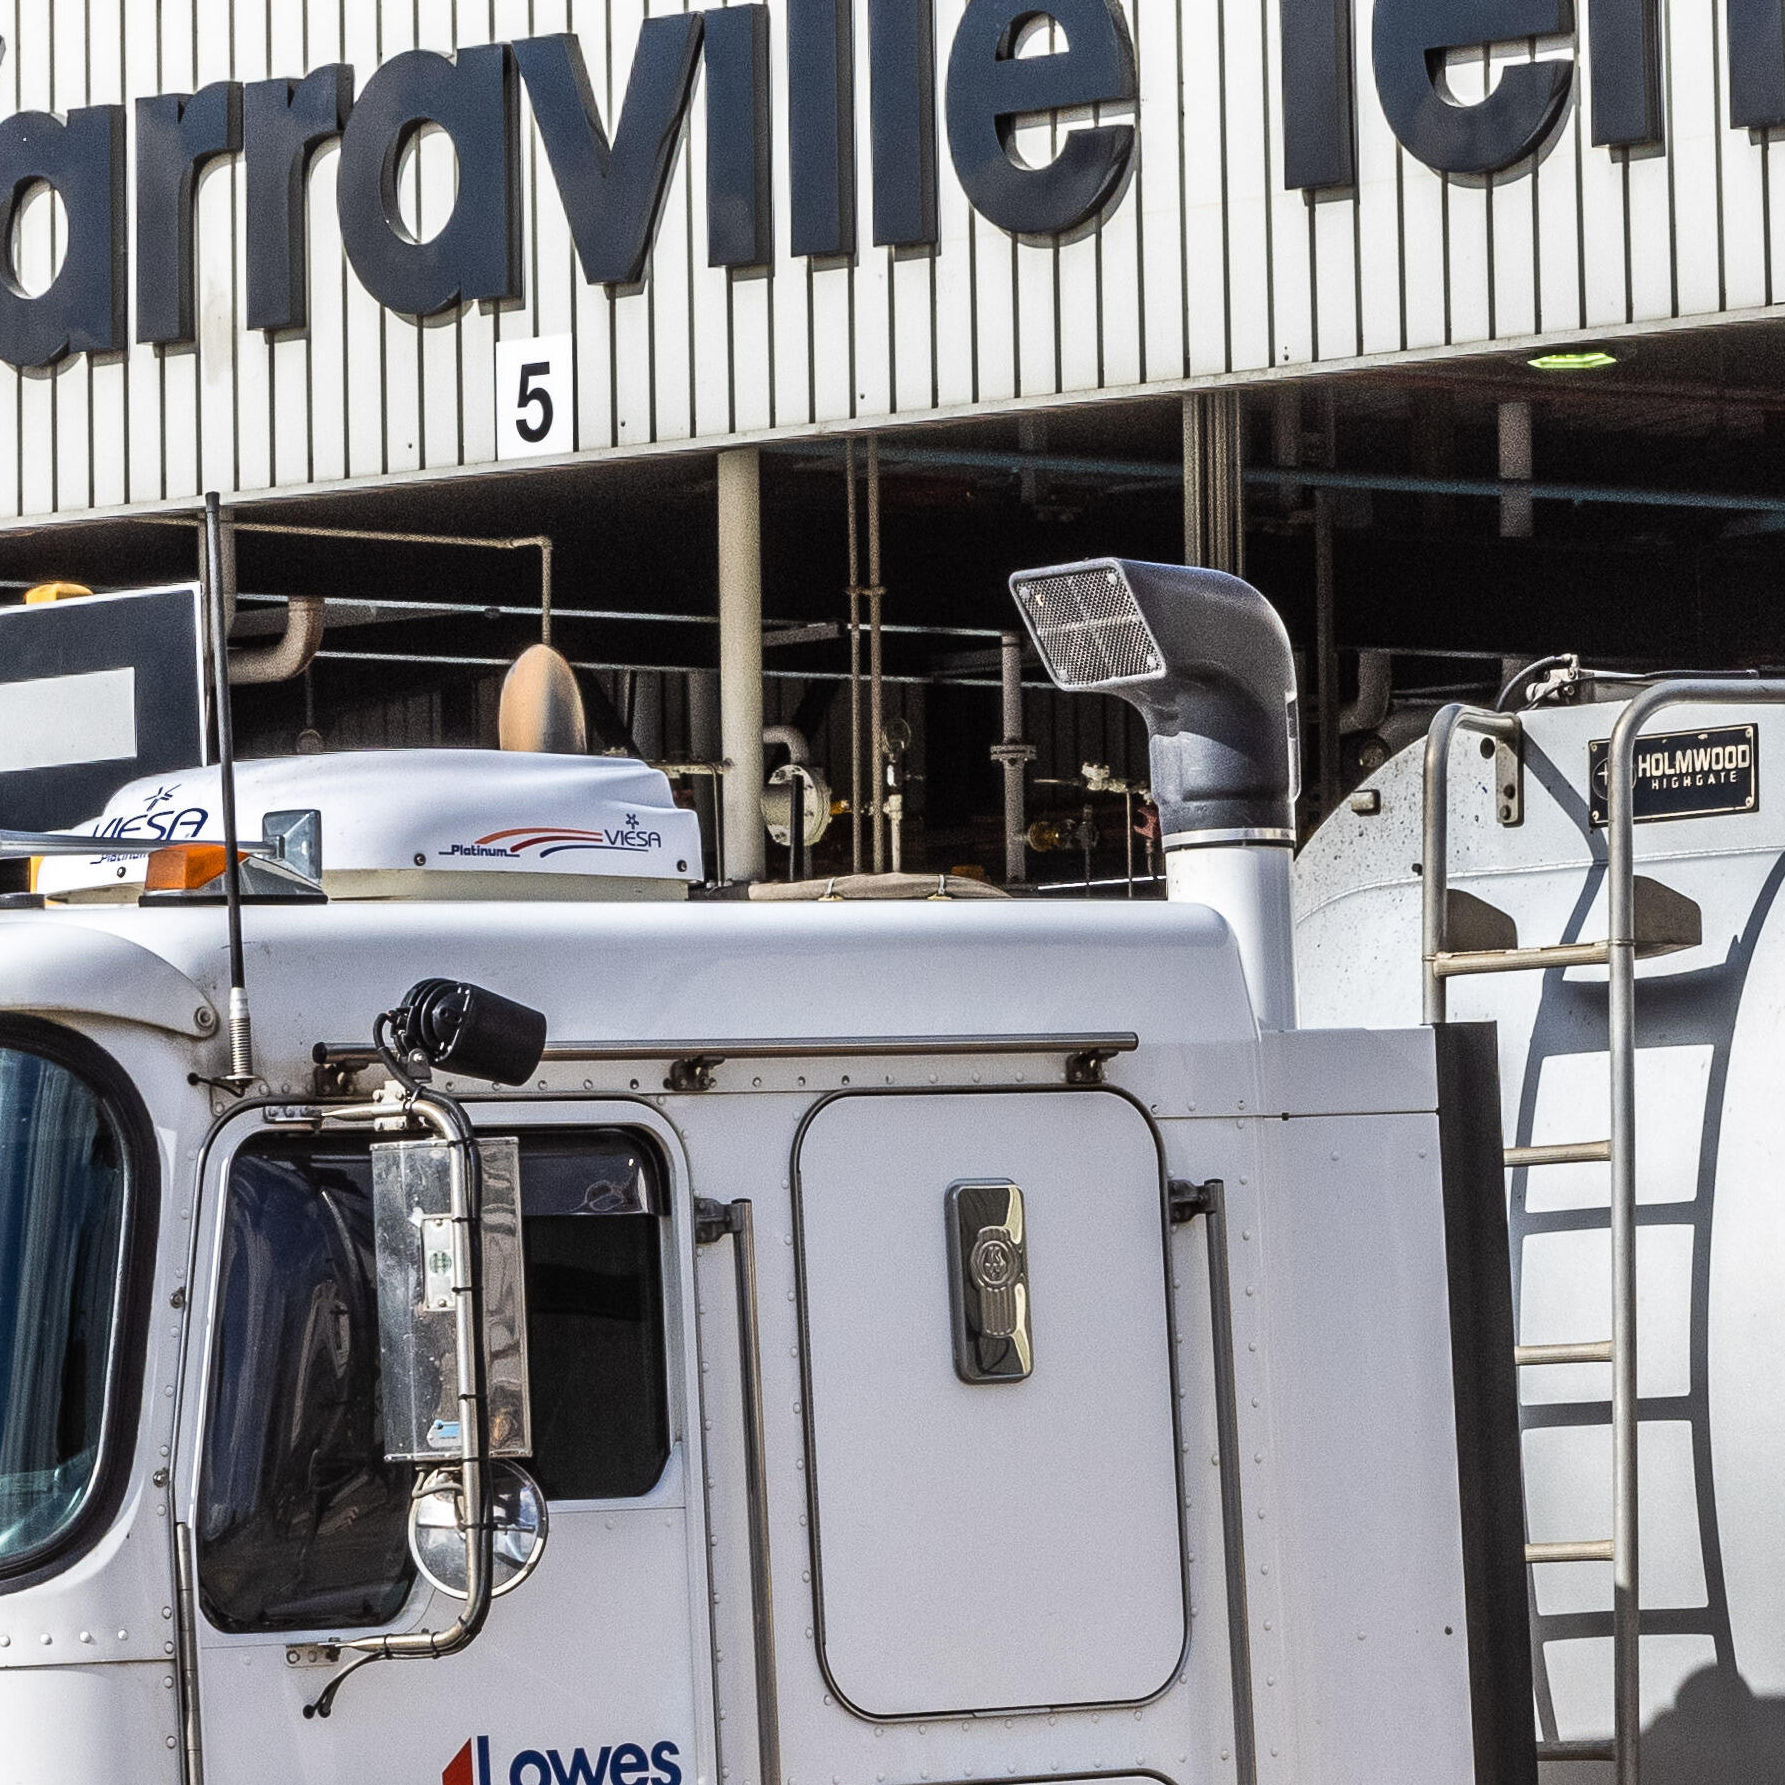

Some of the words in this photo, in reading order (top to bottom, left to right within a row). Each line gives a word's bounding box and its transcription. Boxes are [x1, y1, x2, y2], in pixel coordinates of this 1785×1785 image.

[515, 360, 554, 446] 5
[1638, 744, 1750, 777] HOLMWOOD
[1651, 771, 1737, 789] HIGHGATE
[605, 830, 662, 848] VIESA
[451, 844, 508, 857] Platinum
